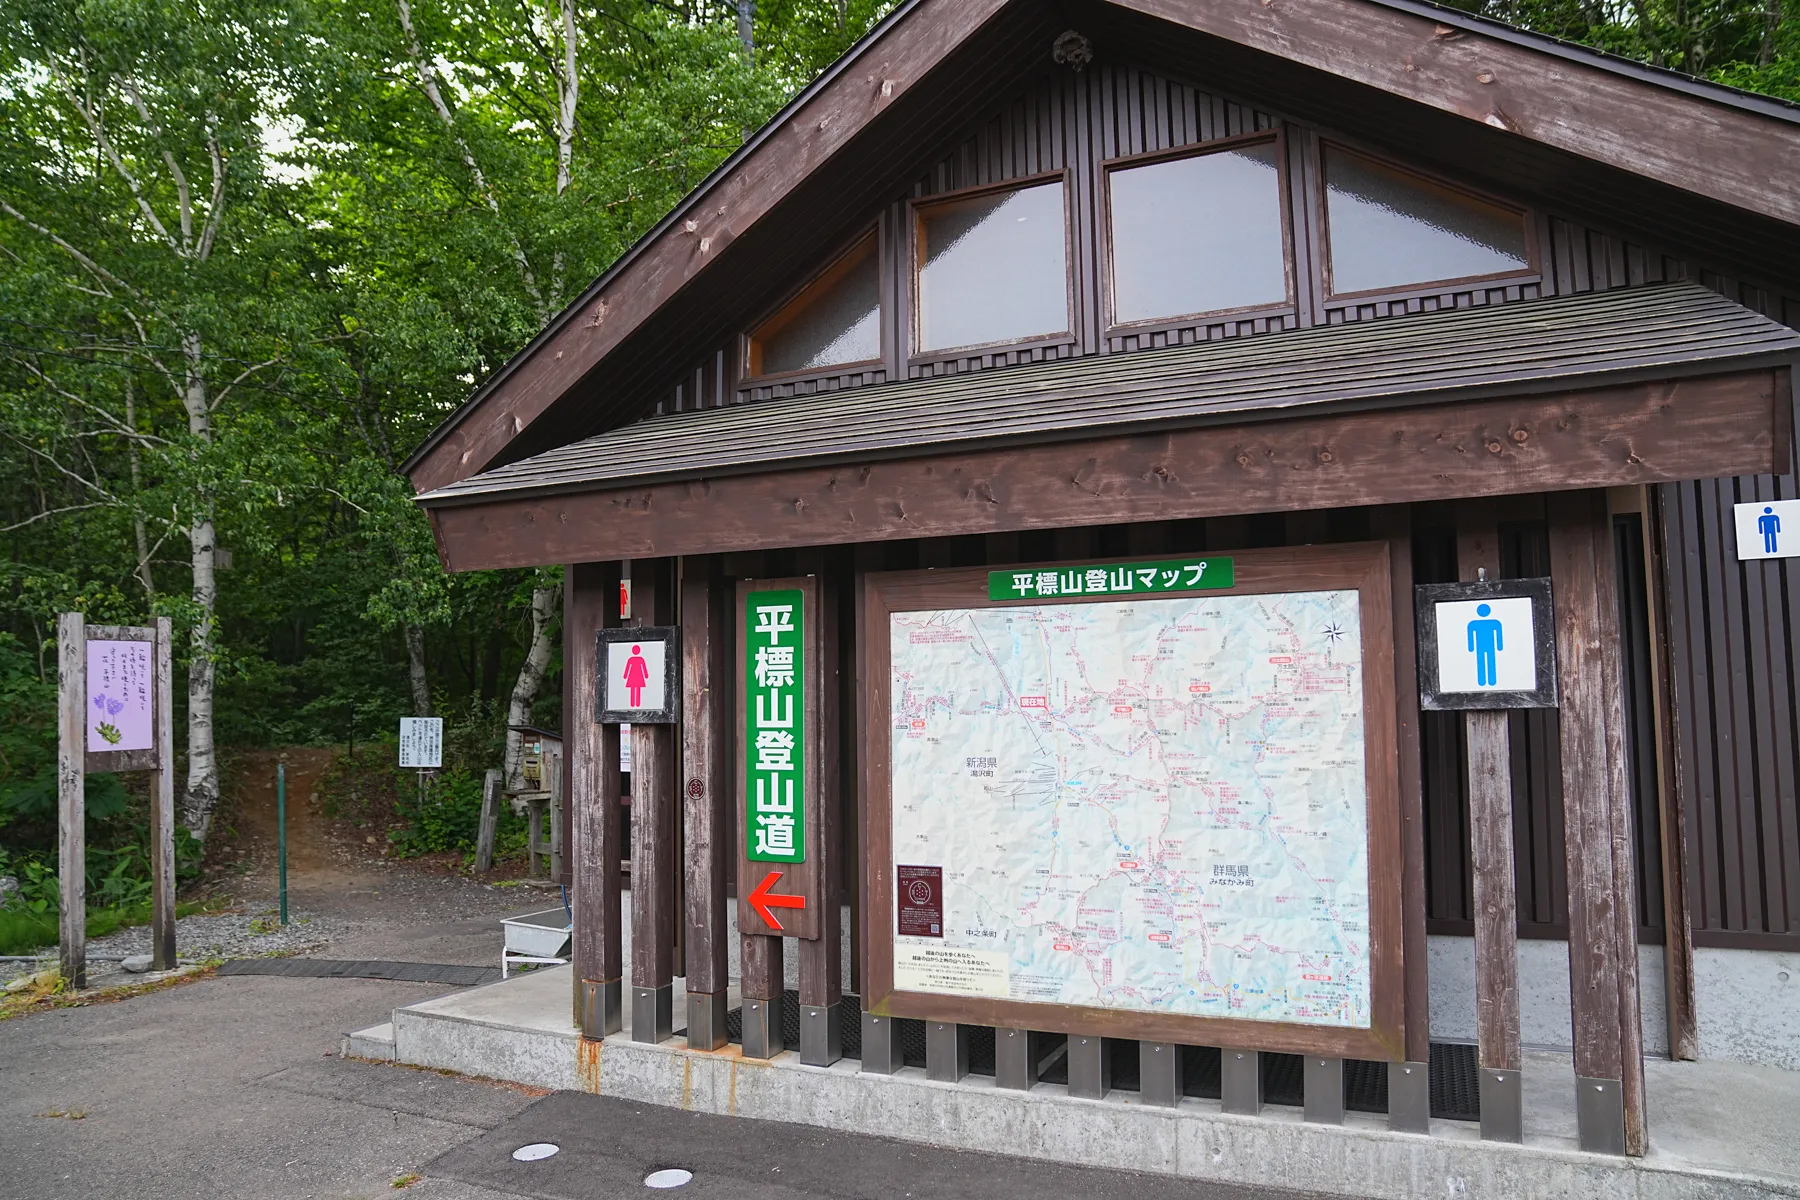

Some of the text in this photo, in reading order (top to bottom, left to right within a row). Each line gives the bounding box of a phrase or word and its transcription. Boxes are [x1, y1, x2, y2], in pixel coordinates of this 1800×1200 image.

[1012, 561, 1207, 596] 平標山登山マップ
[1021, 697, 1045, 707] 現在地
[754, 604, 796, 856] 平標山登山道
[966, 757, 997, 768] 新潟県
[1213, 865, 1249, 877] 群馬県
[1209, 879, 1254, 887] みなかみ町
[965, 929, 997, 938] 中之条町
